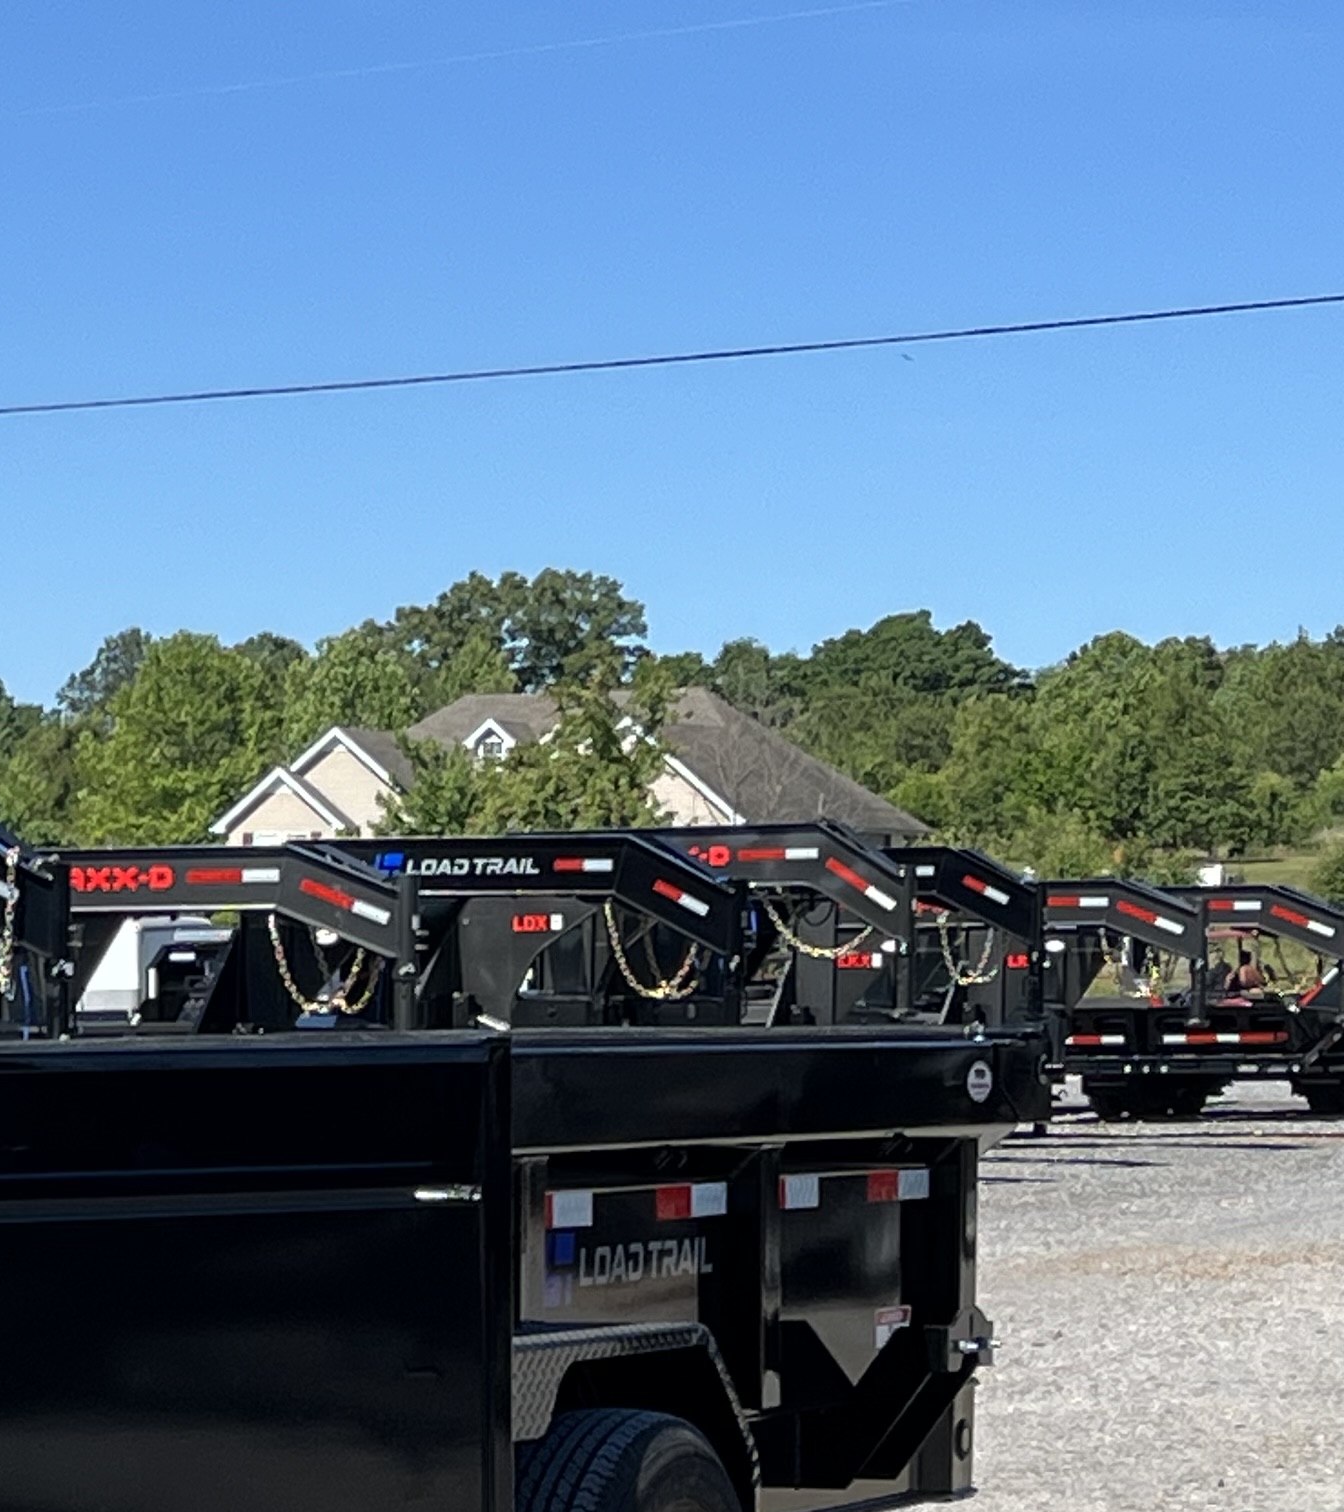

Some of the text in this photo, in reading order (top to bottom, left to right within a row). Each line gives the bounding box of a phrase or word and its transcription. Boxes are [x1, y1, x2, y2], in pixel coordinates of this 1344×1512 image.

[68, 864, 175, 893] AXX-D
[406, 857, 540, 876] LOAD TRAIL
[512, 914, 550, 933] LDX
[579, 1235, 713, 1287] LOAD TRAIL
